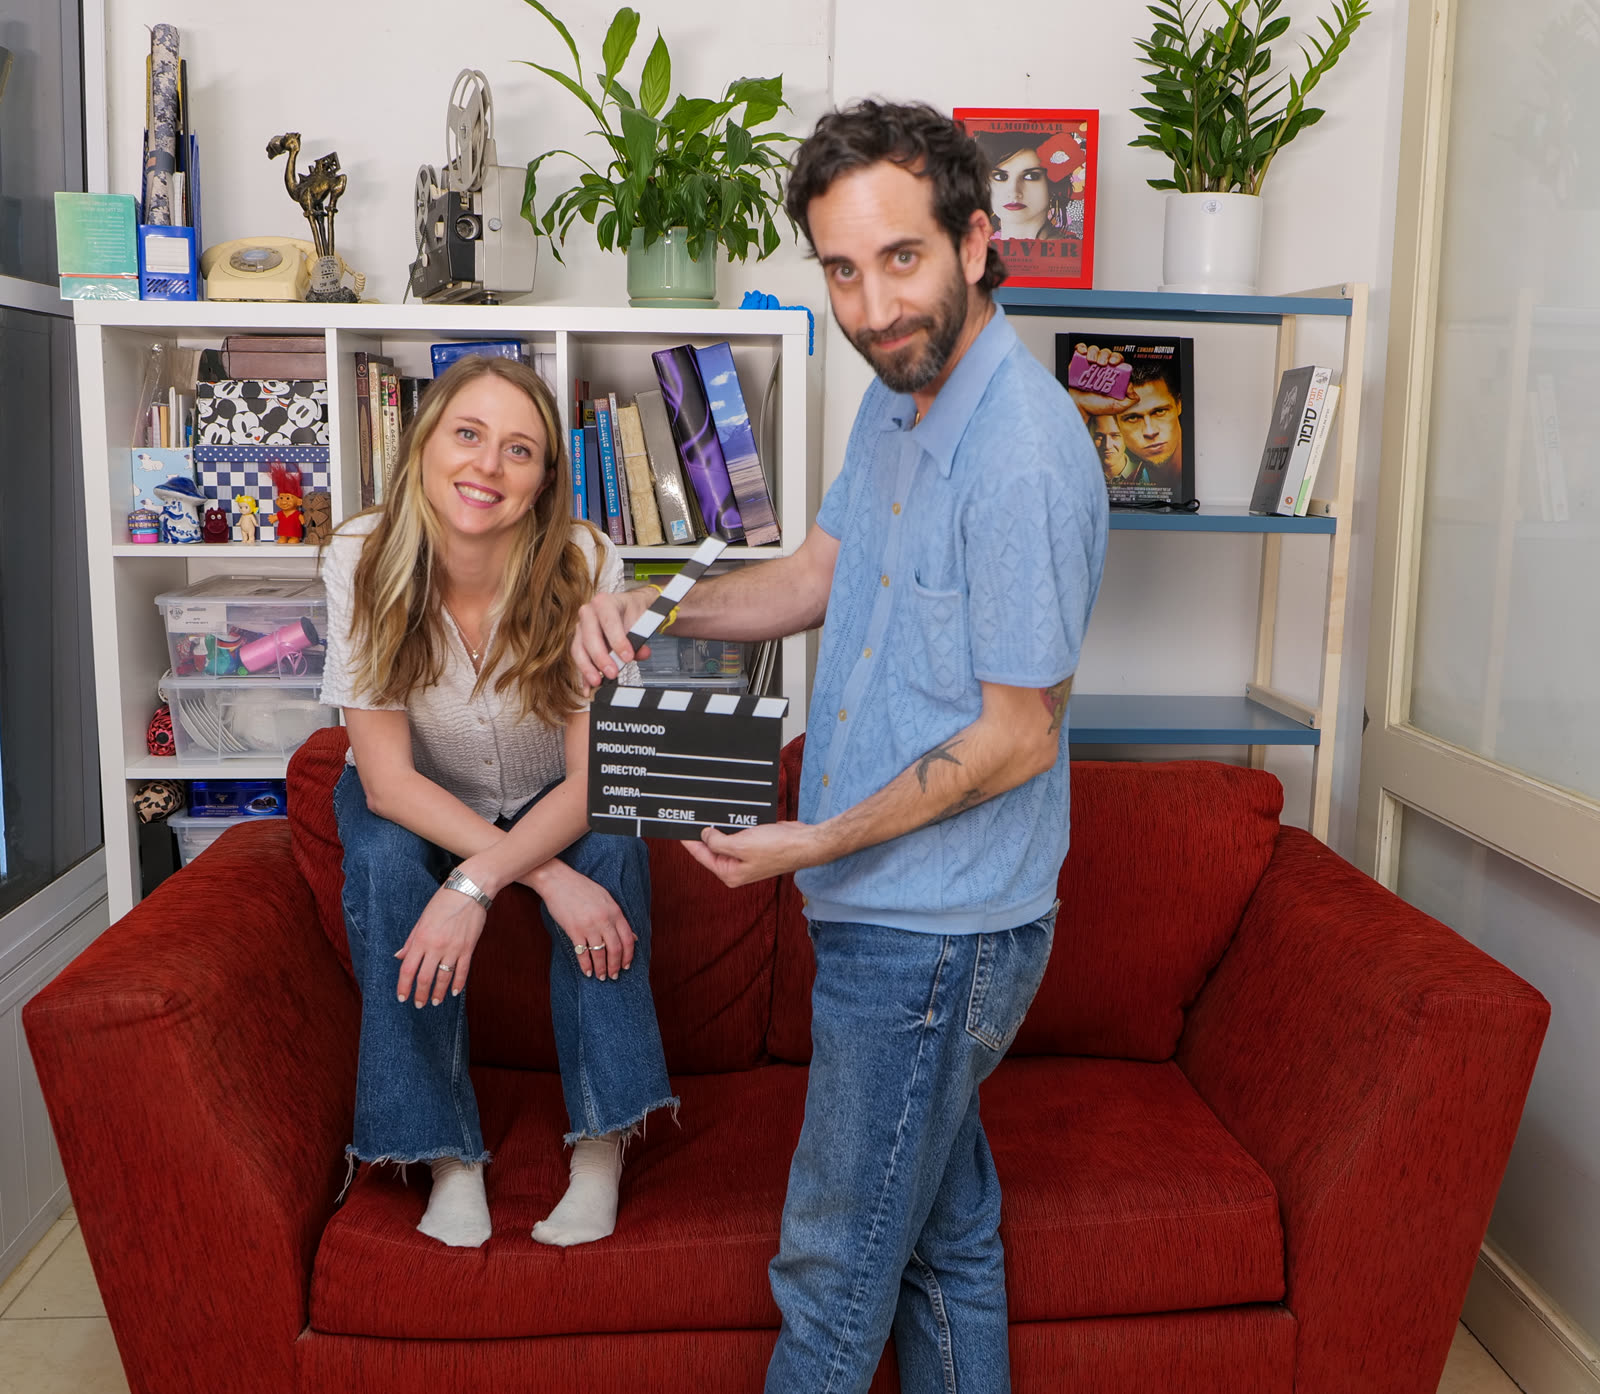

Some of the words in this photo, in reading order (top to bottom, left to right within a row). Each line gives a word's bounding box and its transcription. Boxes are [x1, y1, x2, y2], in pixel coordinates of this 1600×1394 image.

[989, 122, 1063, 131] ALMODOVAR
[990, 241, 1079, 257] LVER
[1124, 344, 1136, 352] PITT
[1154, 346, 1175, 354] NORTON
[1087, 363, 1120, 380] FIGHT
[1078, 370, 1116, 393] CLUB
[1297, 407, 1317, 447] סיפור
[1265, 447, 1289, 470] סיפור
[596, 721, 666, 735] HOLLYWOOD
[596, 743, 656, 756] PRODUCTION
[601, 764, 647, 776] DIRECTOR
[602, 786, 641, 798] CAMERA
[609, 804, 637, 816] DATE
[658, 808, 695, 820] SCENE
[728, 814, 758, 825] TAKE
